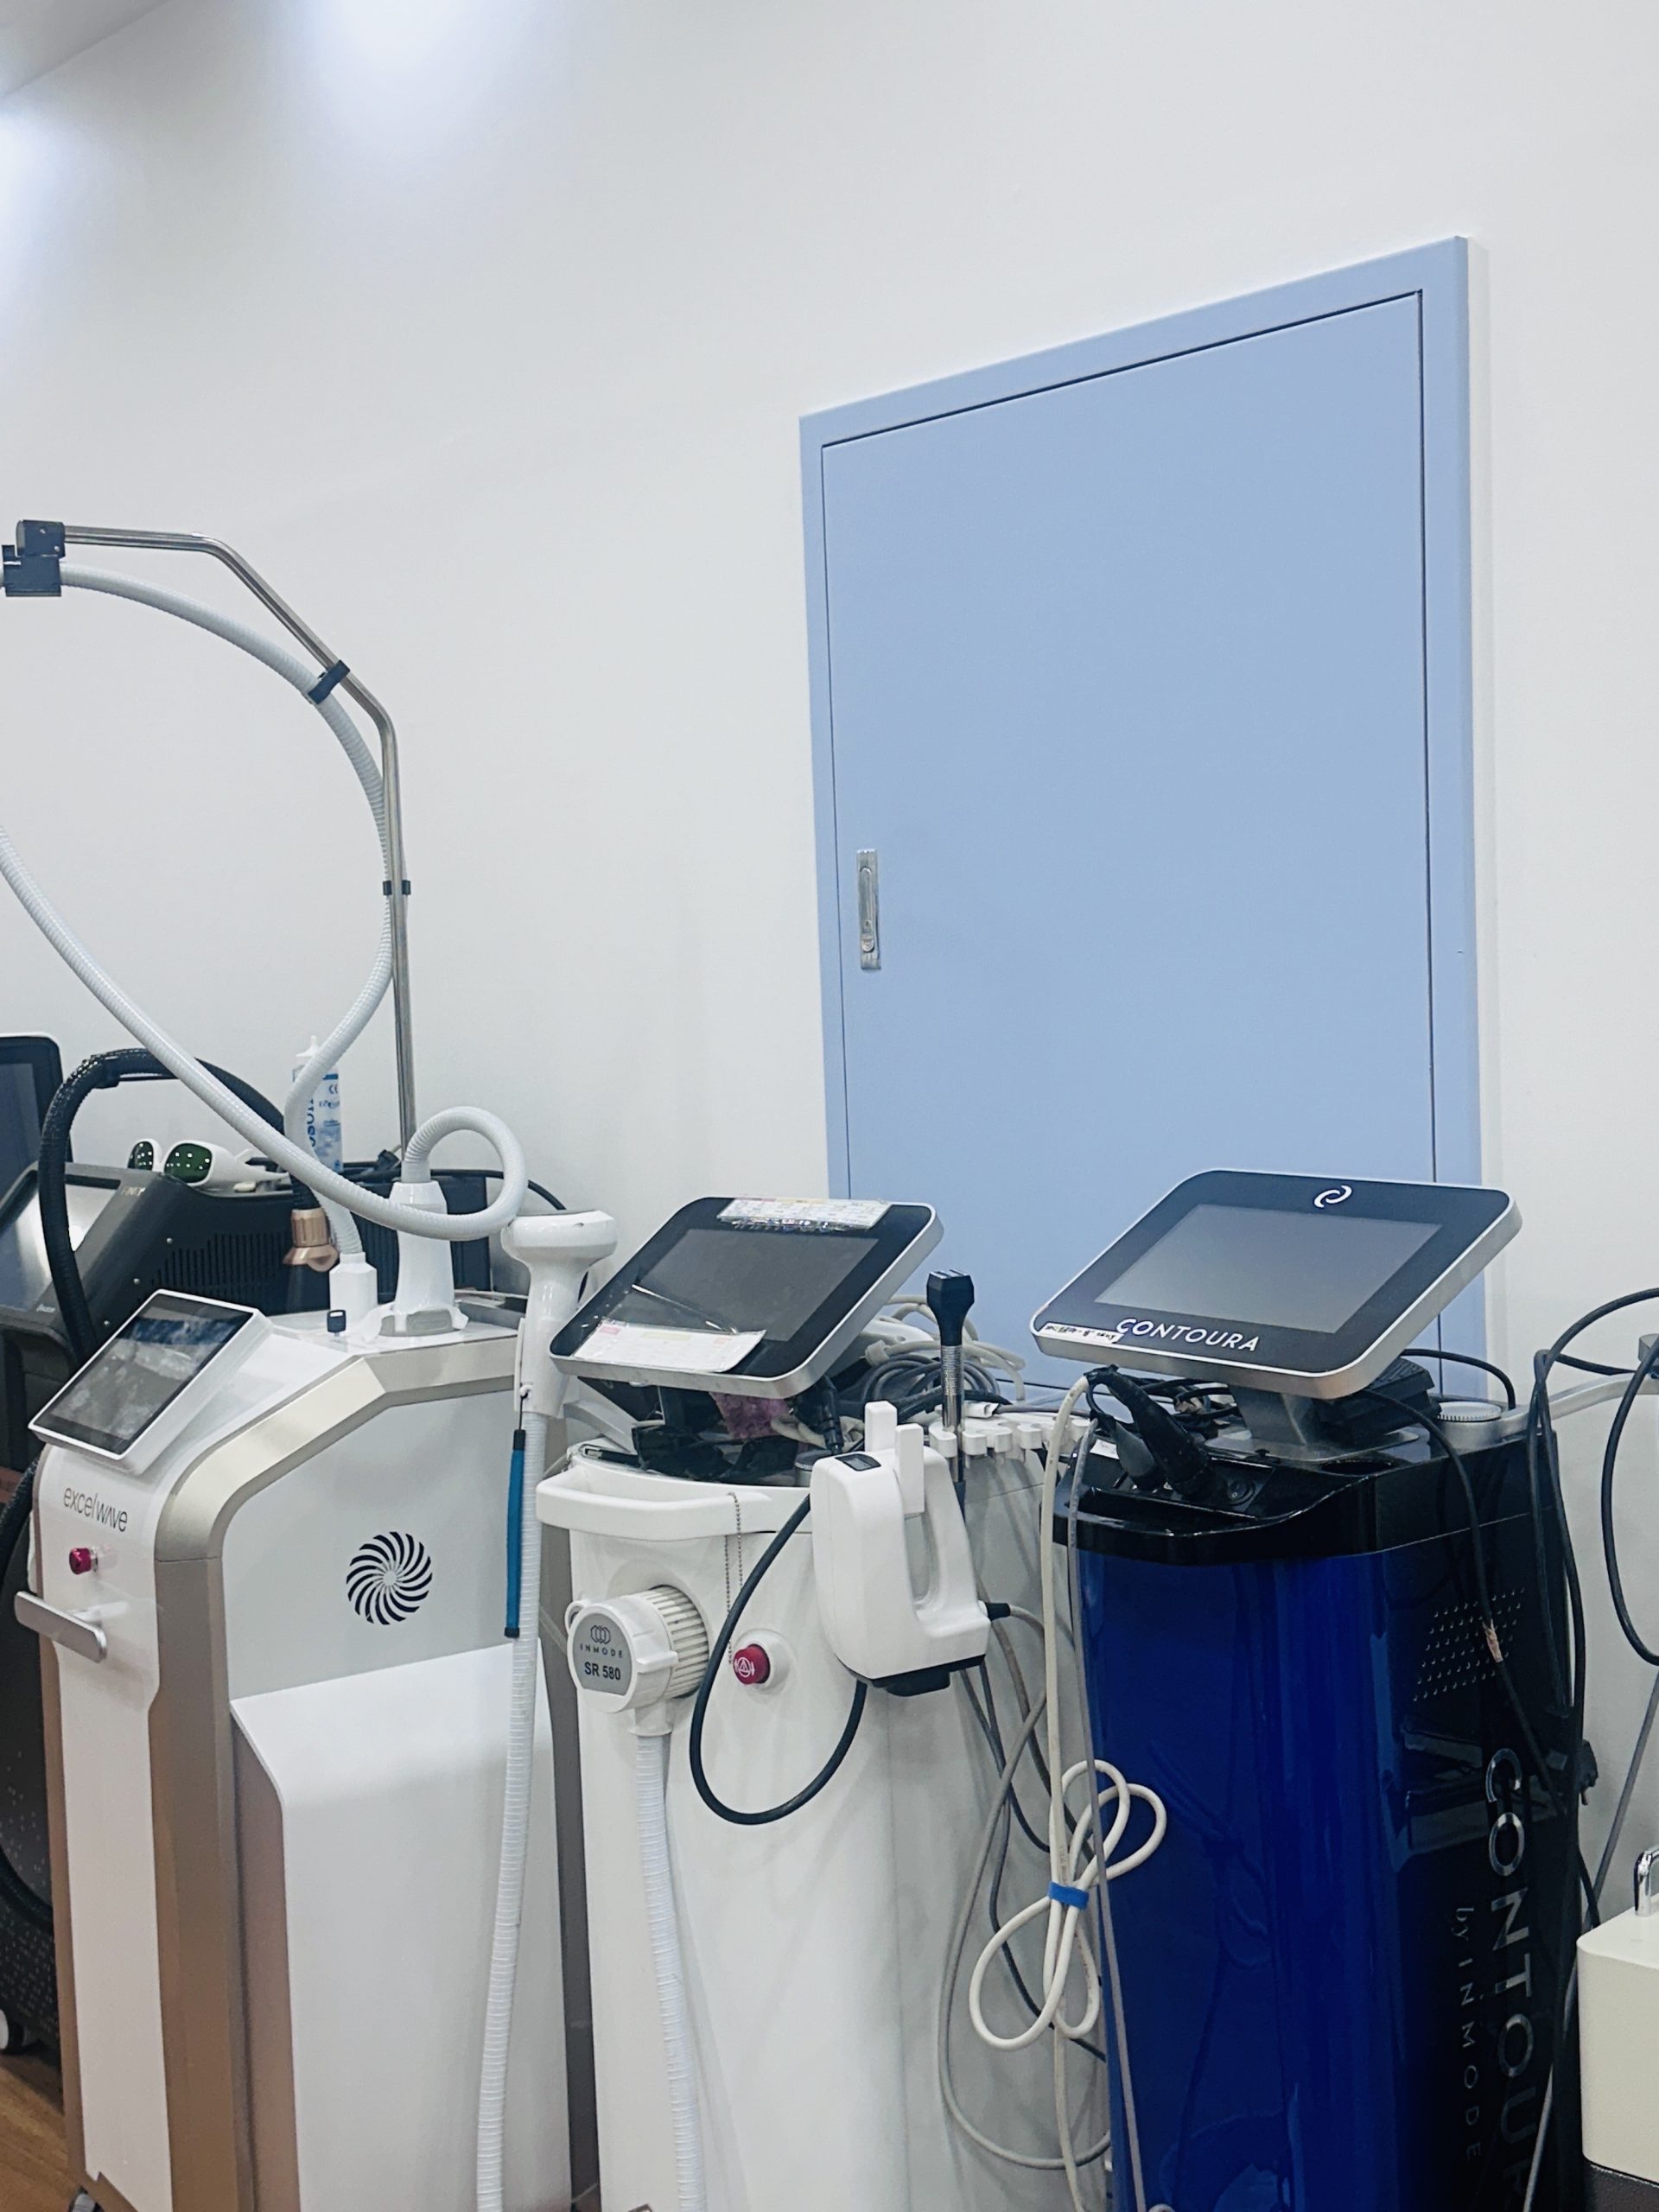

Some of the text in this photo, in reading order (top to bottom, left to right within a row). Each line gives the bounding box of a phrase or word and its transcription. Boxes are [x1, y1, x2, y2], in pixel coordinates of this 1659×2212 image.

[1116, 1317, 1260, 1352] CONTOURA
[580, 1643, 623, 1658] INMODE
[584, 1661, 621, 1681] SR 580
[1452, 1906, 1483, 2160] by INMODE
